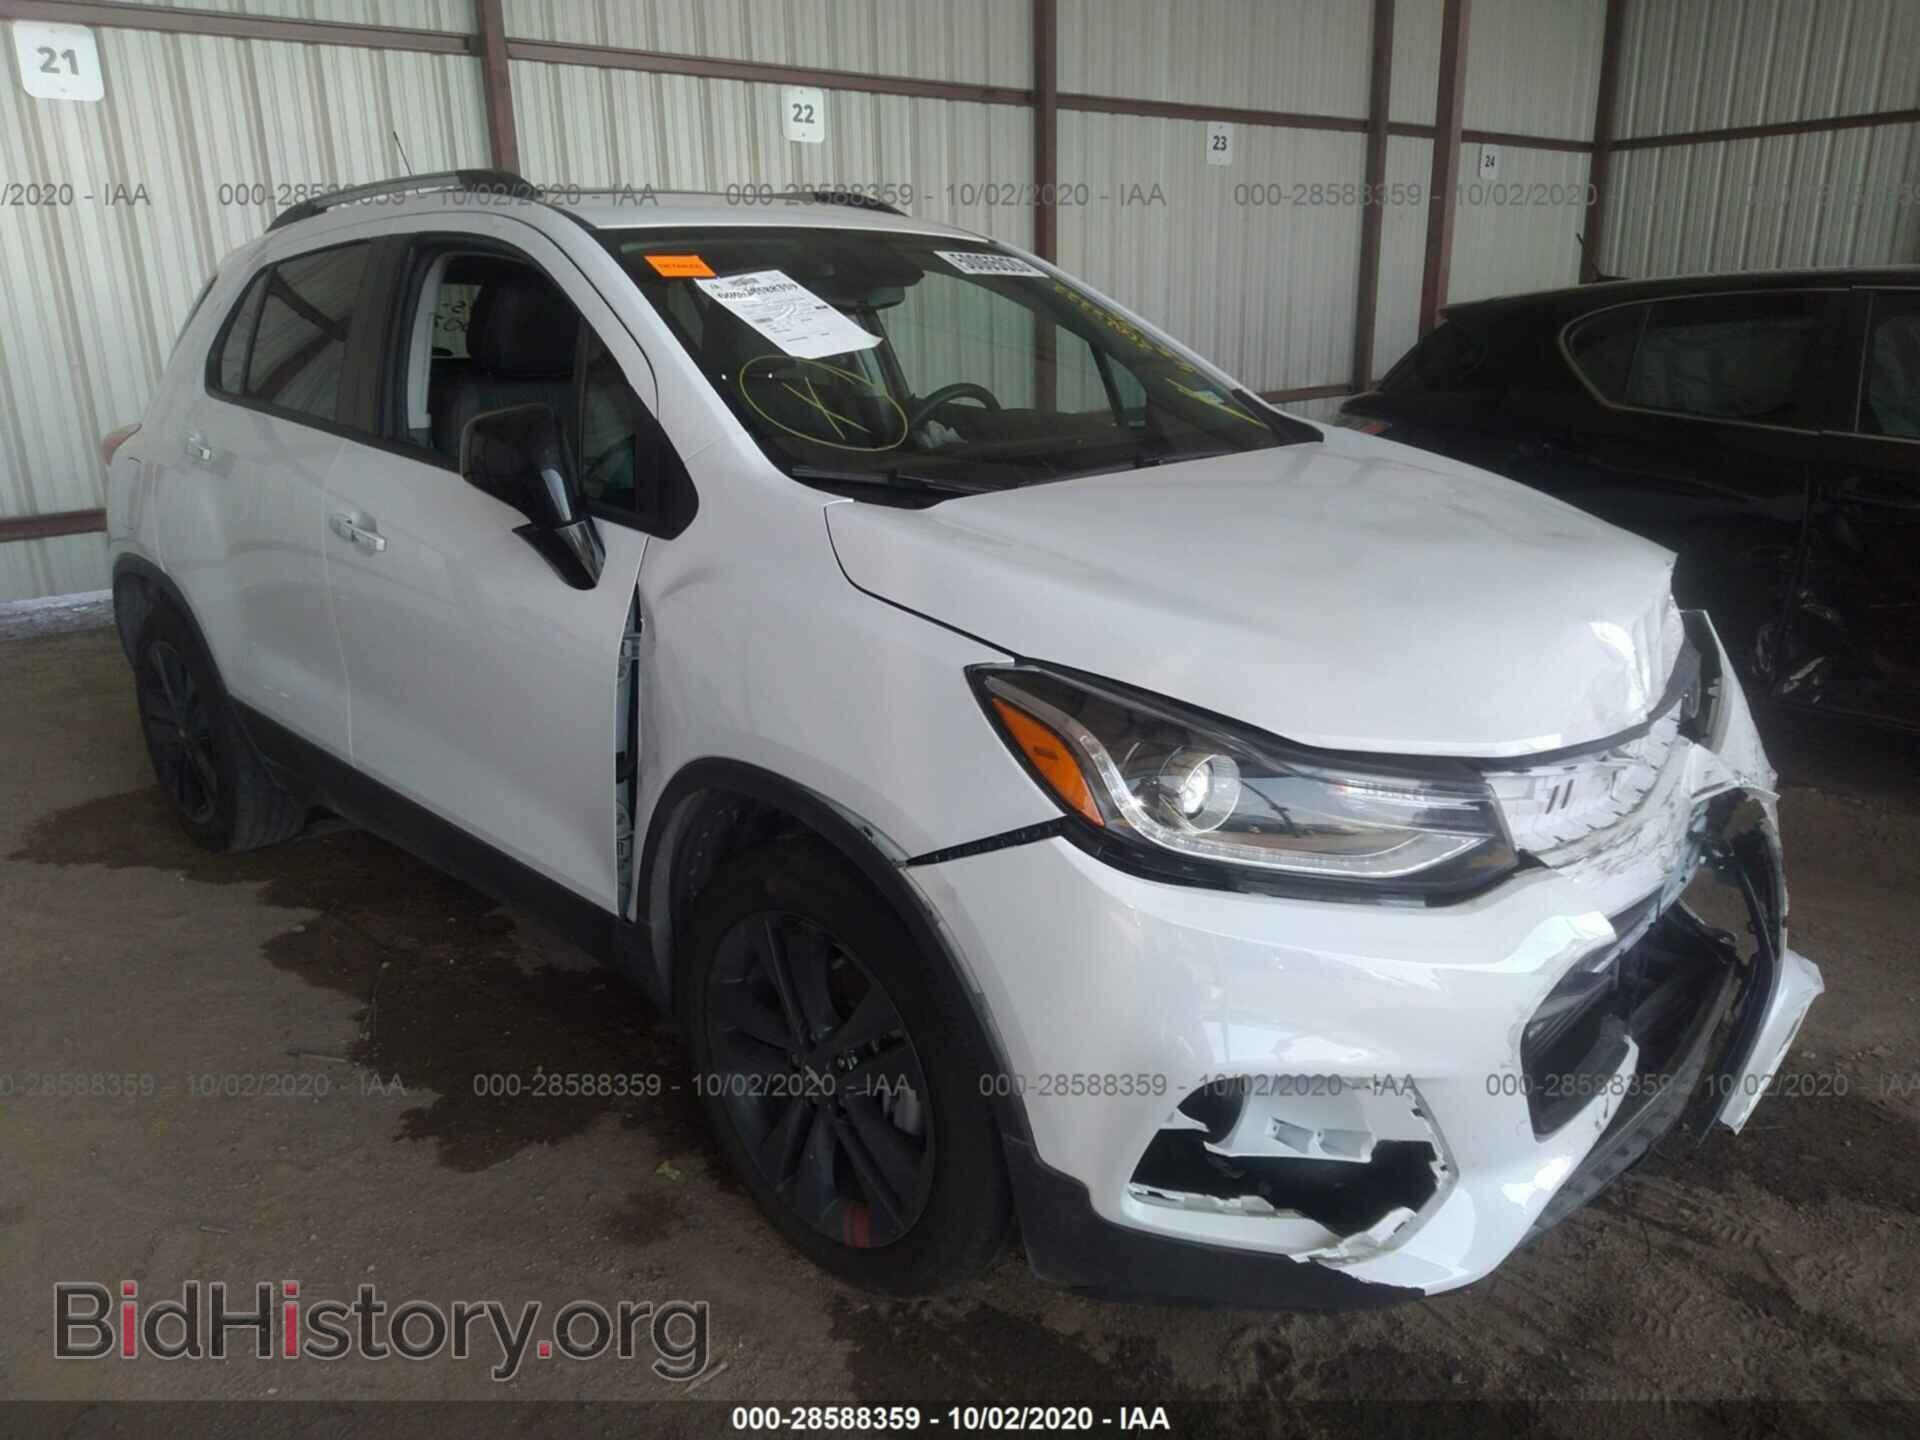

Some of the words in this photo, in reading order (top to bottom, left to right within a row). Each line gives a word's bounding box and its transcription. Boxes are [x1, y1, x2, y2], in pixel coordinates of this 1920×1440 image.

[37, 47, 80, 76] 21
[792, 103, 815, 124] 22
[1212, 135, 1228, 151] 23
[1484, 154, 1496, 168] 24
